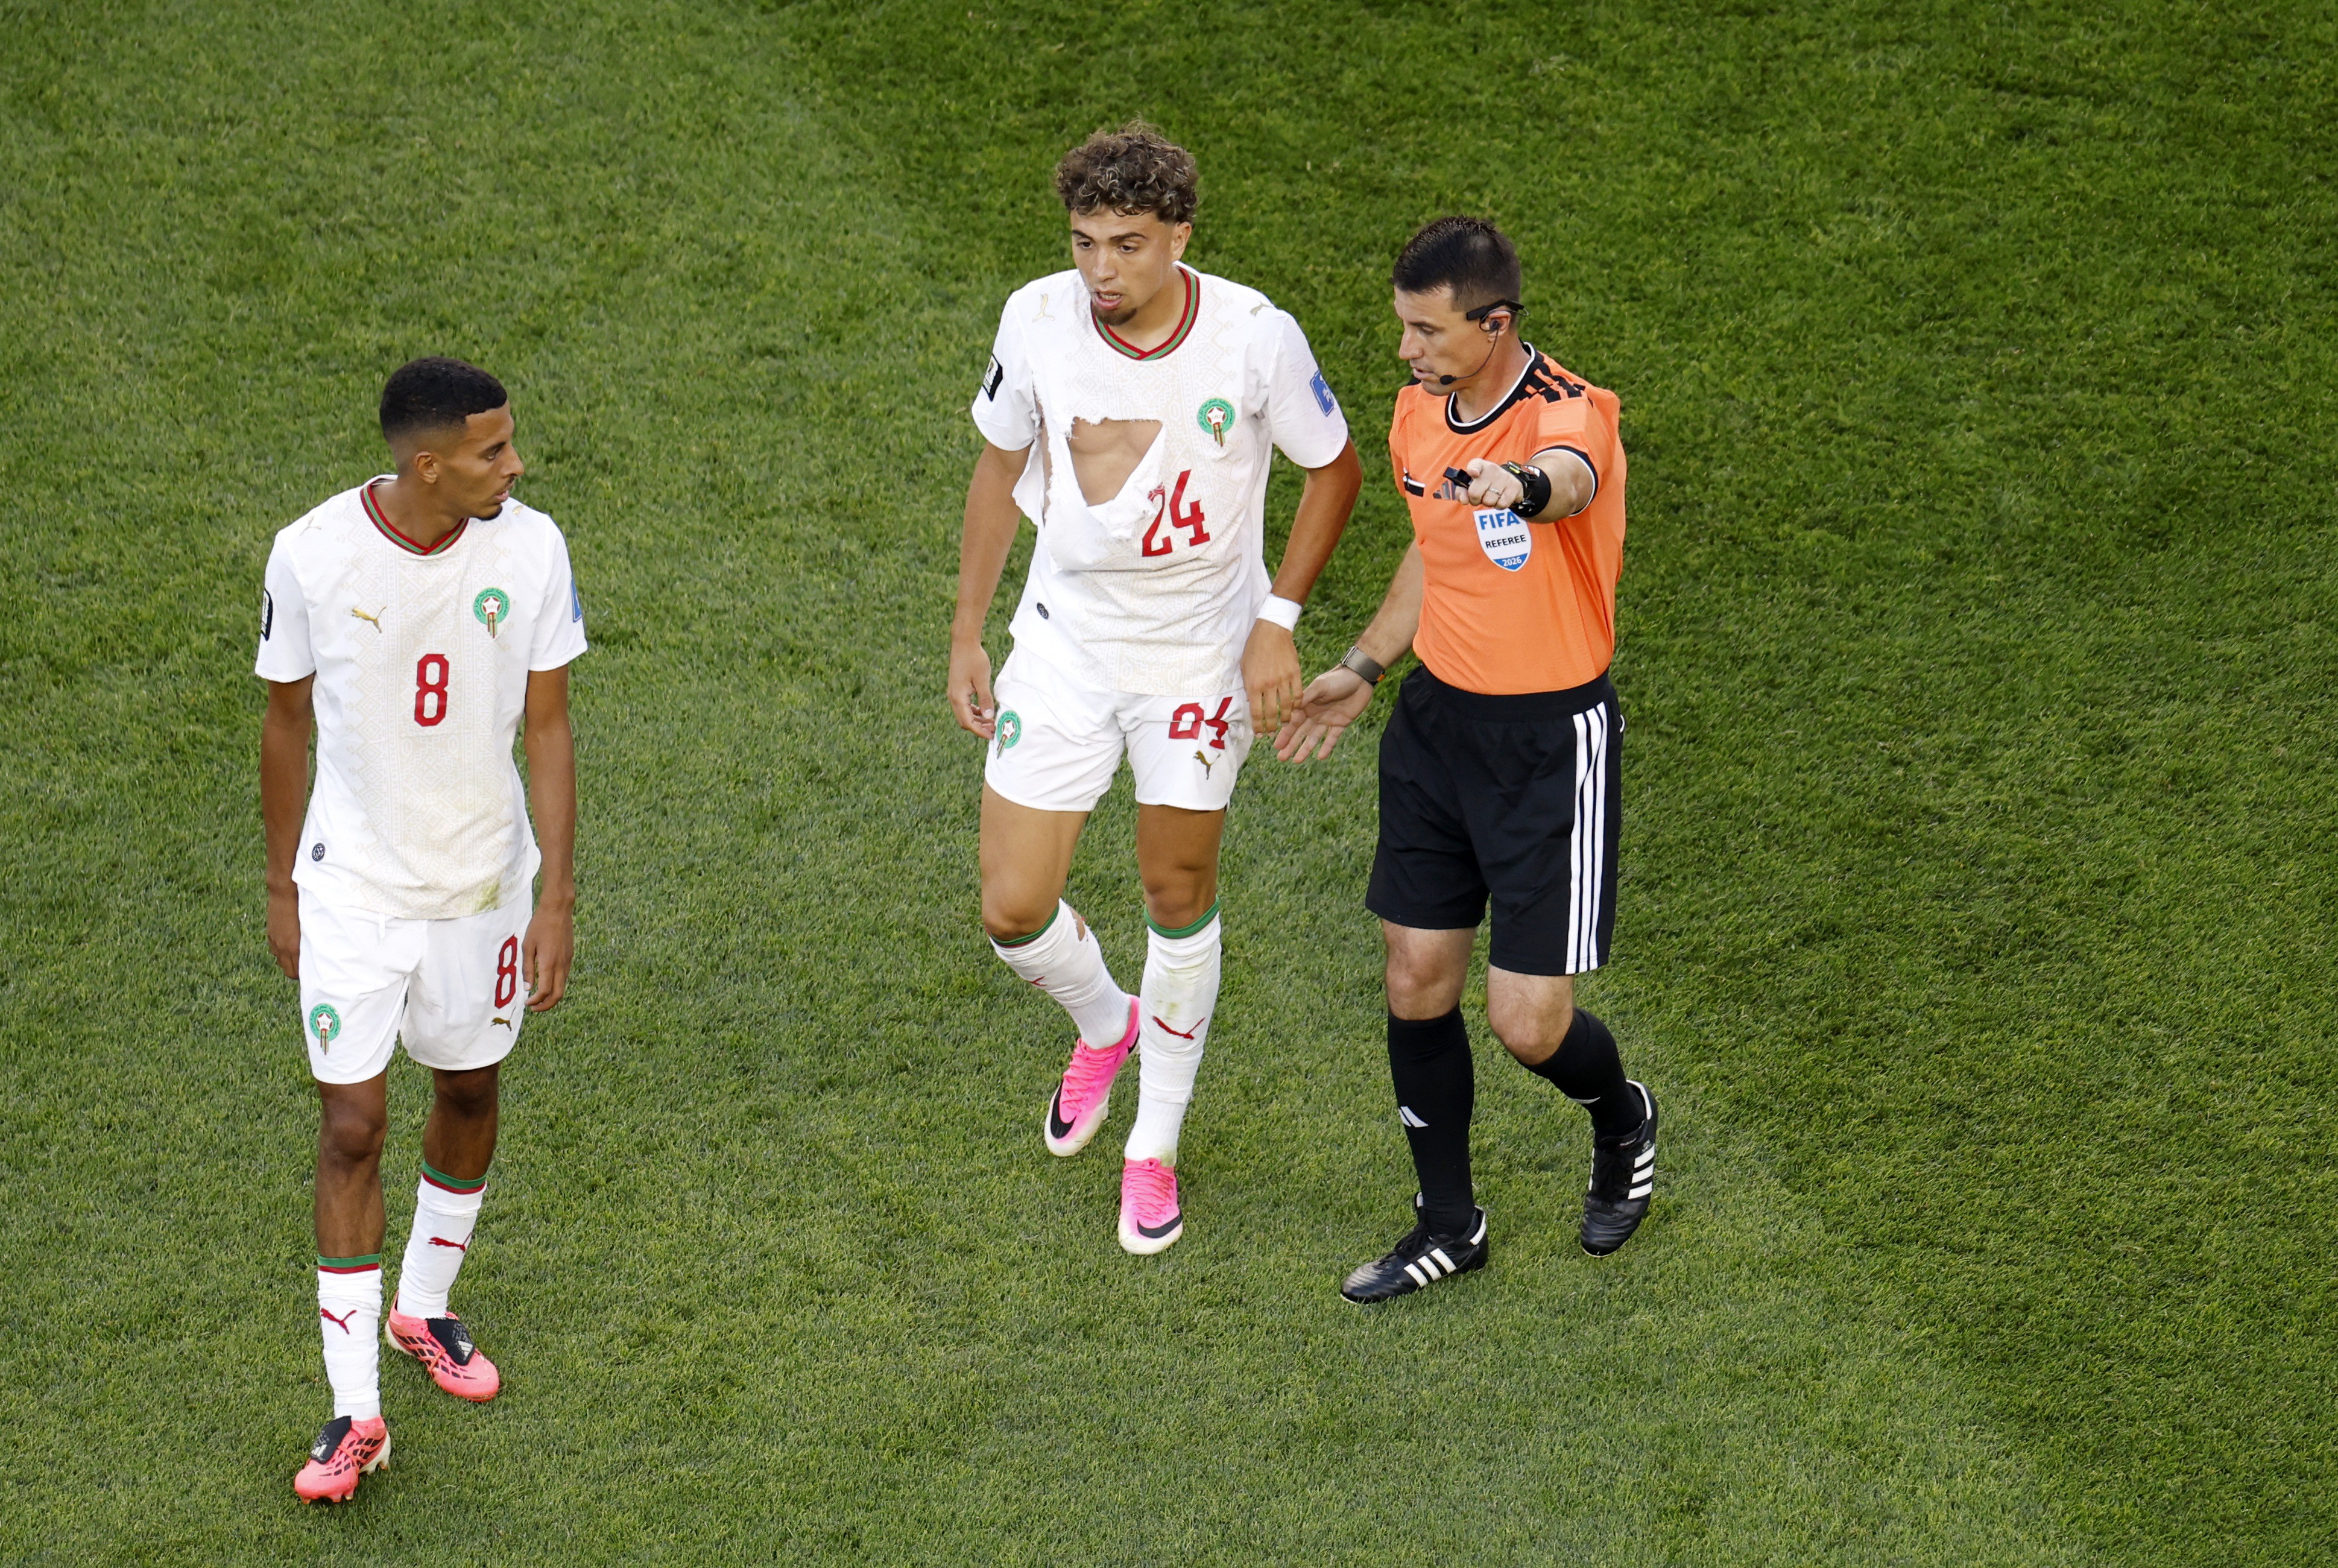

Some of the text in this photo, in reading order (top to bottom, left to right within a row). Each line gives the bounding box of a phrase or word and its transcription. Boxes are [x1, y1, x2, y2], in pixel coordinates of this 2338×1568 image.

[1142, 469, 1210, 557] 24
[1479, 511, 1520, 530] FIFA
[1485, 534, 1527, 548] REFEREE
[1502, 557, 1522, 566] 2026
[414, 654, 449, 727] 8
[494, 932, 517, 1009] 8
